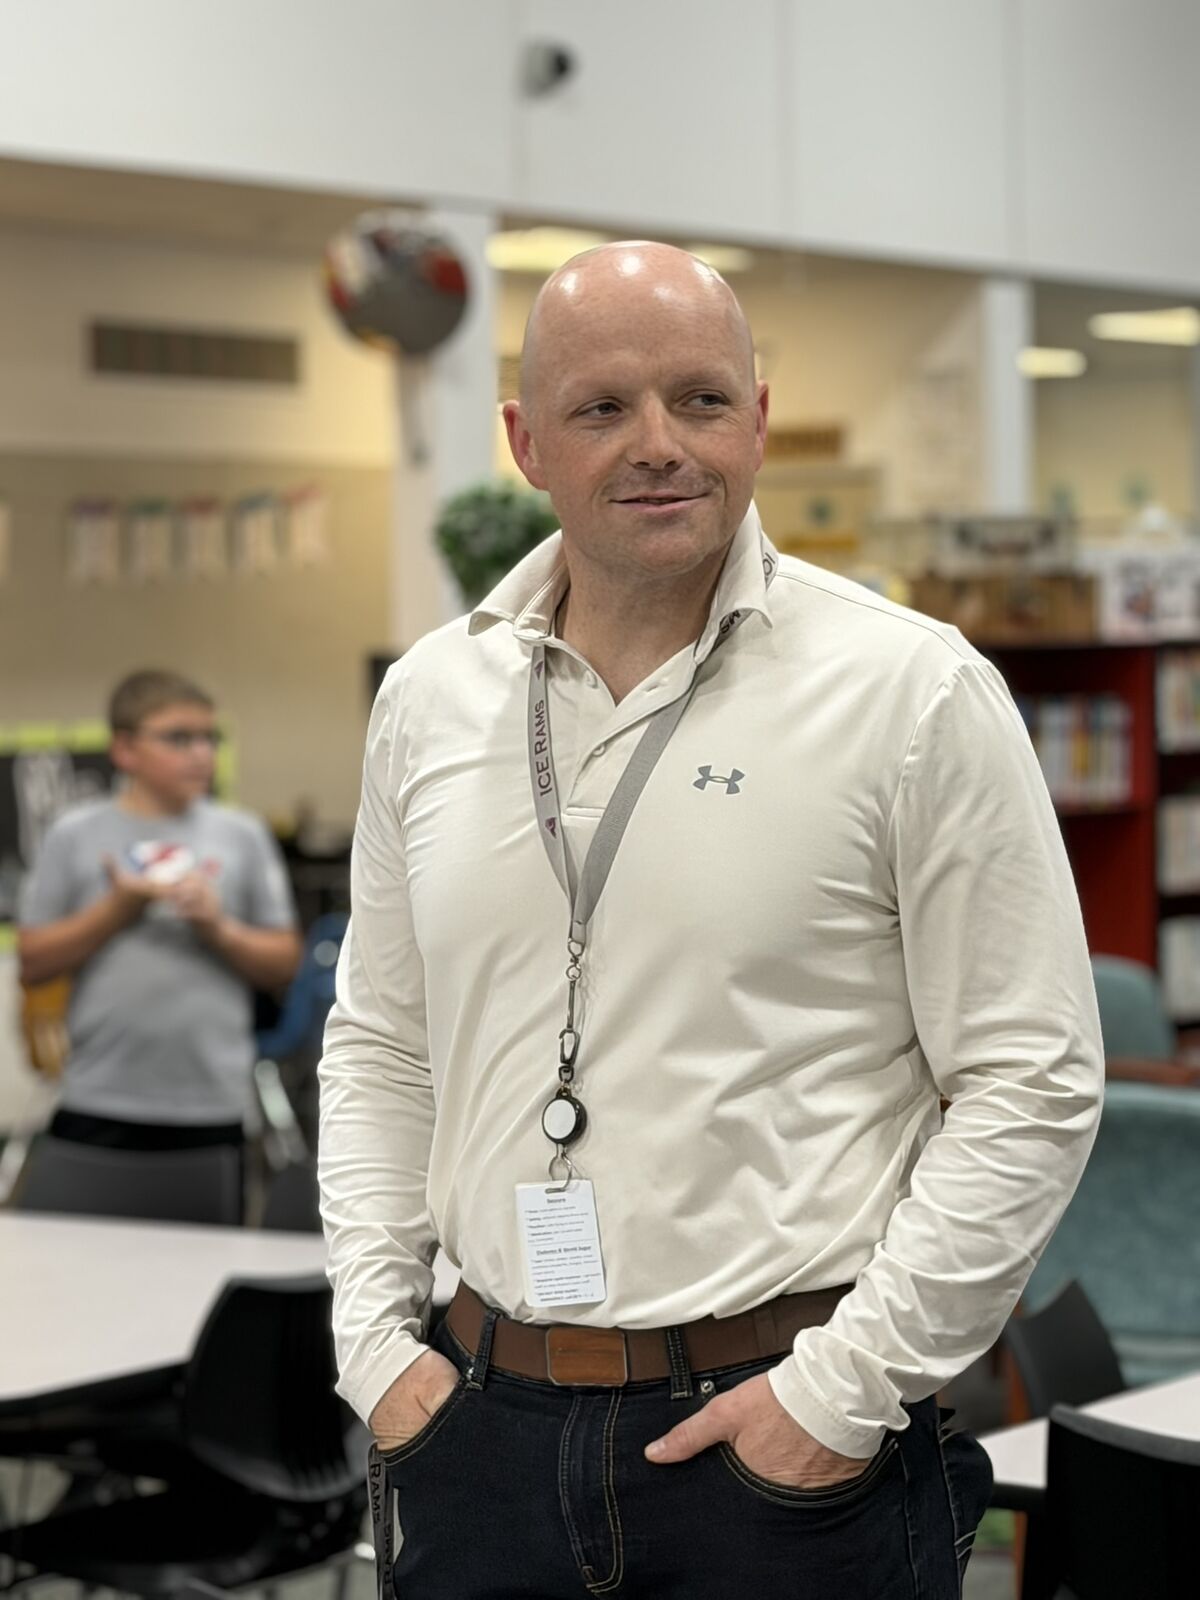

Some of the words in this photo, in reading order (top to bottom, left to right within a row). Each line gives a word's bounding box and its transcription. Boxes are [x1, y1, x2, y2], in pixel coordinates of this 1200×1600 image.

[534, 699, 547, 756] RAMS
[536, 757, 552, 797] ICE
[370, 1462, 381, 1525] RAMS
